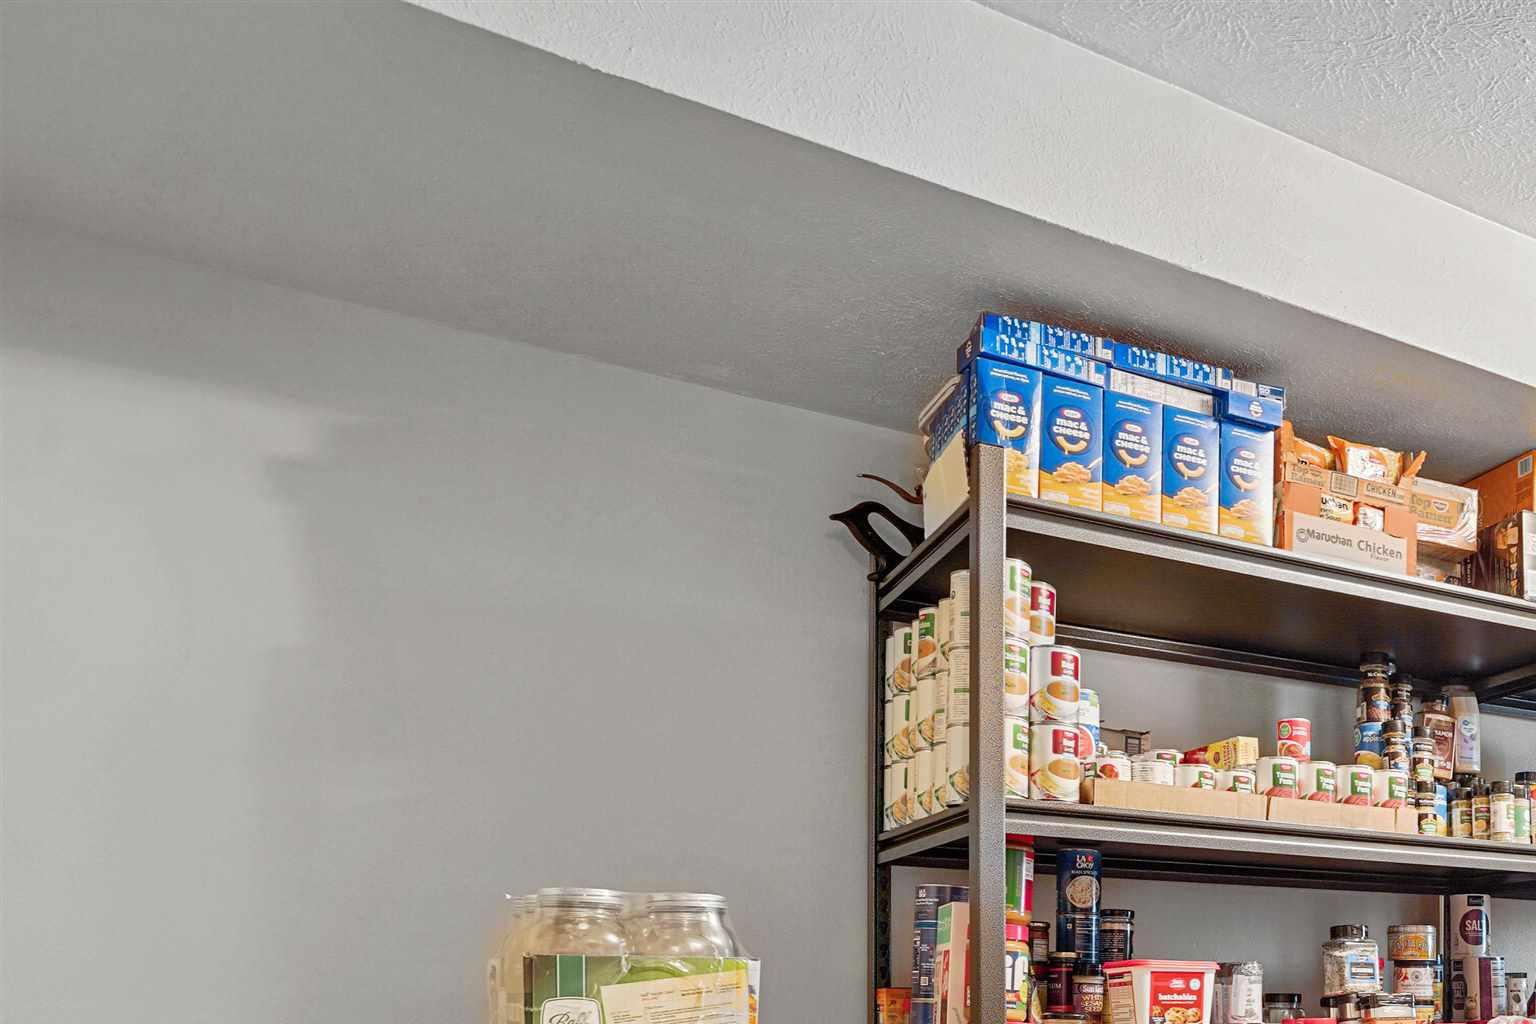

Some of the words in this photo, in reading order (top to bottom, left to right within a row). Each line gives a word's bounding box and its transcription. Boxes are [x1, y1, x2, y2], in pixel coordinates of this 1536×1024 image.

[1366, 482, 1396, 497] CHICKEN
[1411, 493, 1430, 506] Top
[1307, 528, 1352, 547] Maruchan
[1357, 540, 1402, 560] Chicken
